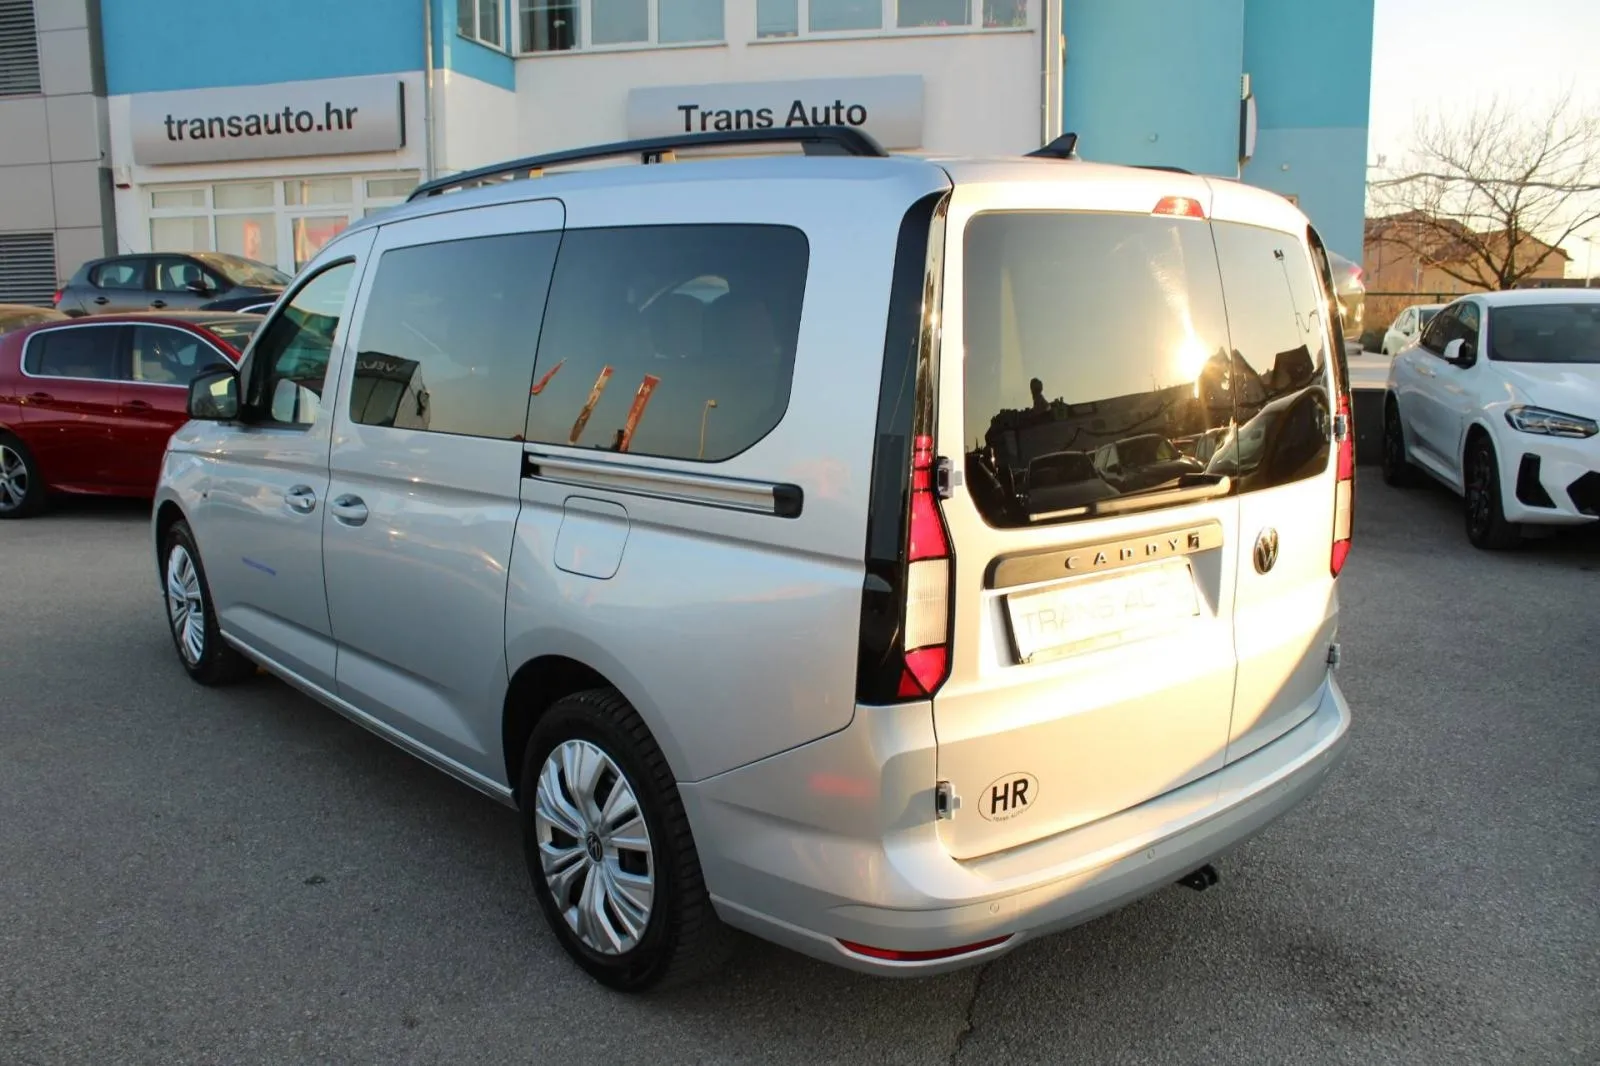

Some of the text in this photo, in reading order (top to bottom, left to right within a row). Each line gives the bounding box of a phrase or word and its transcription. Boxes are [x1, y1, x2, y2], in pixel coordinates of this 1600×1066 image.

[164, 102, 358, 141] transauto.hr
[677, 99, 868, 133] Trans Auto
[1064, 538, 1180, 570] CADDY
[991, 778, 1029, 815] HR
